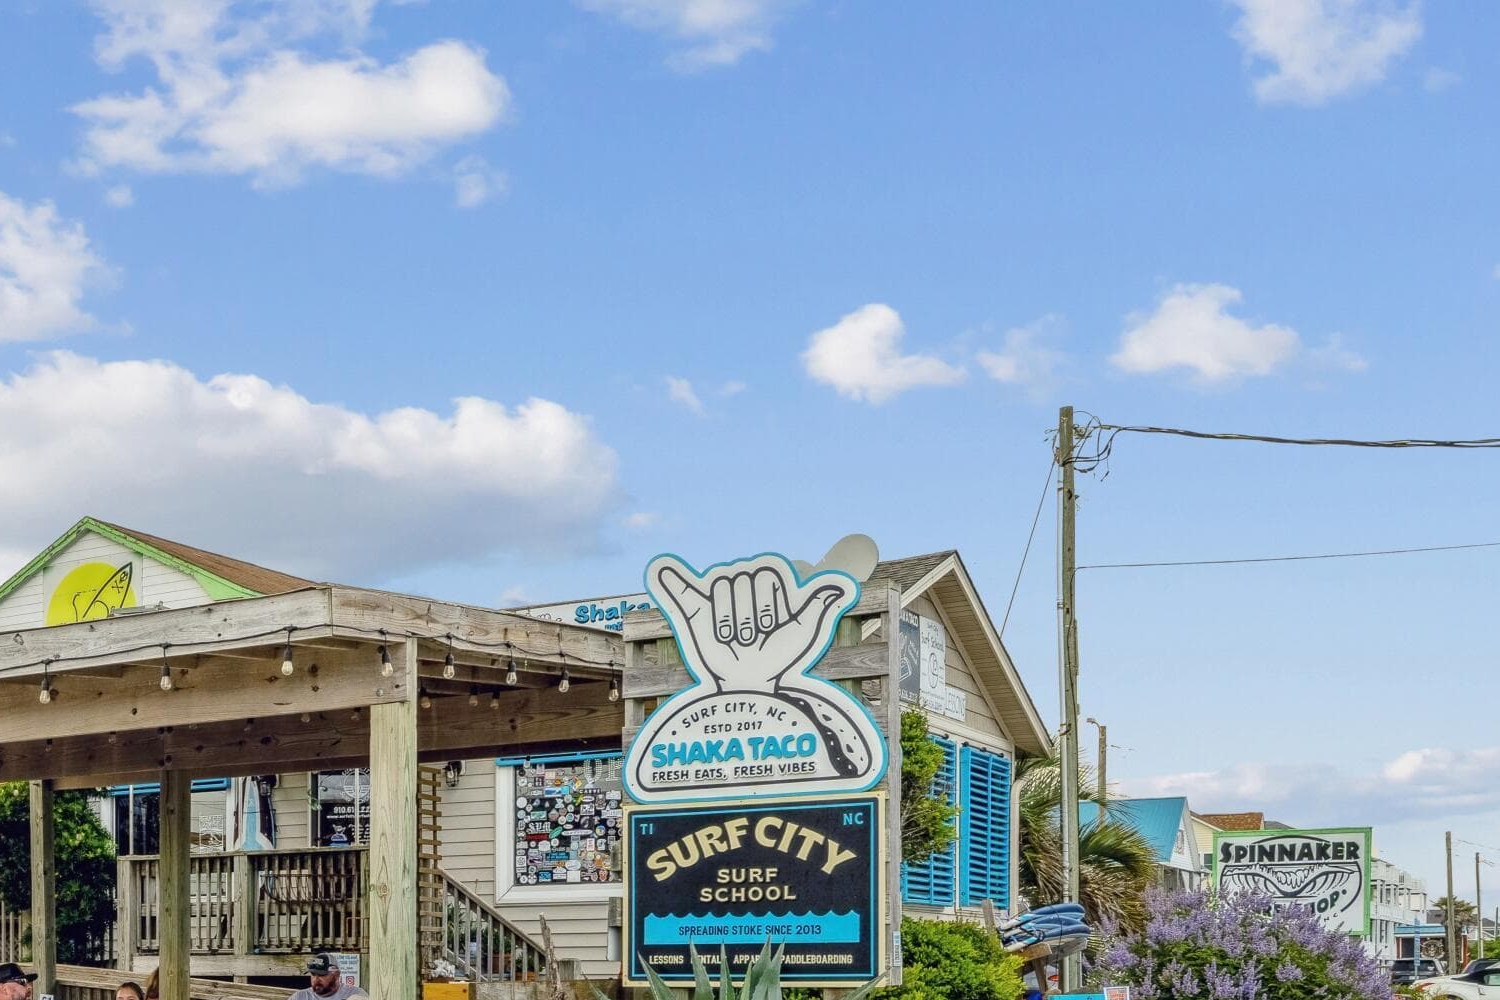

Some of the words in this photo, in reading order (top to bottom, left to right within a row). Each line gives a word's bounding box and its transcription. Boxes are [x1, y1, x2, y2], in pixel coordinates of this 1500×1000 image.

[682, 704, 718, 729] SURF
[724, 701, 757, 716] CITY,
[766, 705, 787, 722] NC
[703, 723, 732, 734] ESTD
[737, 720, 763, 732] 2017
[651, 736, 745, 769] SHAKA
[747, 732, 817, 761] TACO
[652, 769, 689, 782] FRESH
[694, 767, 728, 780] EATS,
[733, 764, 773, 777] FRESH
[778, 761, 817, 774] VIBES
[842, 812, 864, 825] NC
[639, 823, 654, 835] TI
[646, 817, 749, 882] SURF
[754, 816, 858, 875] CITY
[1219, 841, 1361, 863] SPINNAKER
[716, 867, 779, 884] SURF
[699, 885, 797, 903] SCHOOL
[678, 925, 729, 936] SPREADING
[732, 925, 763, 935] STOKE
[765, 925, 793, 935] SINCE
[795, 925, 822, 935] 2013
[649, 955, 684, 965] LESSONS
[780, 955, 853, 965] PADDLEBOARDING
